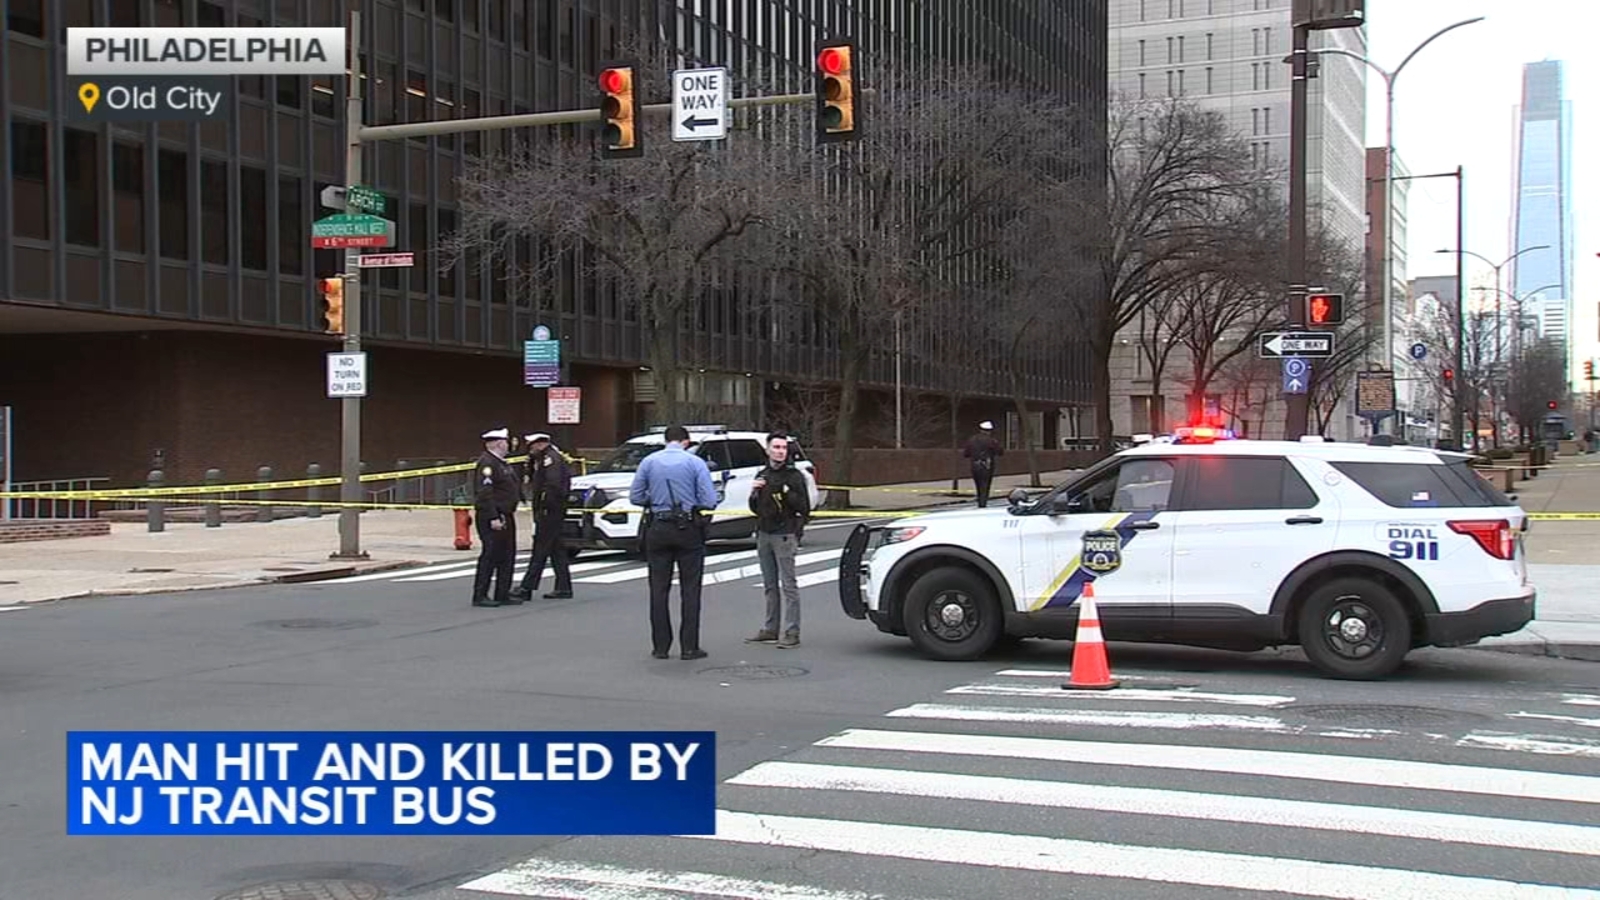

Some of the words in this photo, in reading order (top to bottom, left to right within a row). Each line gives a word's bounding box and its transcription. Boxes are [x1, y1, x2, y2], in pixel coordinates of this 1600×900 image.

[681, 75, 718, 92] ONE
[681, 94, 718, 110] WAY
[348, 192, 375, 210] ARCH
[347, 237, 374, 246] STREET
[1280, 340, 1301, 350] ONE
[1304, 340, 1328, 350] WAY
[339, 357, 355, 367] NO
[334, 370, 360, 379] TURN
[331, 382, 345, 392] ON
[346, 382, 362, 391] RED
[1388, 528, 1438, 540] DIAL
[1086, 540, 1116, 552] POLICE
[1388, 540, 1439, 560] 911
